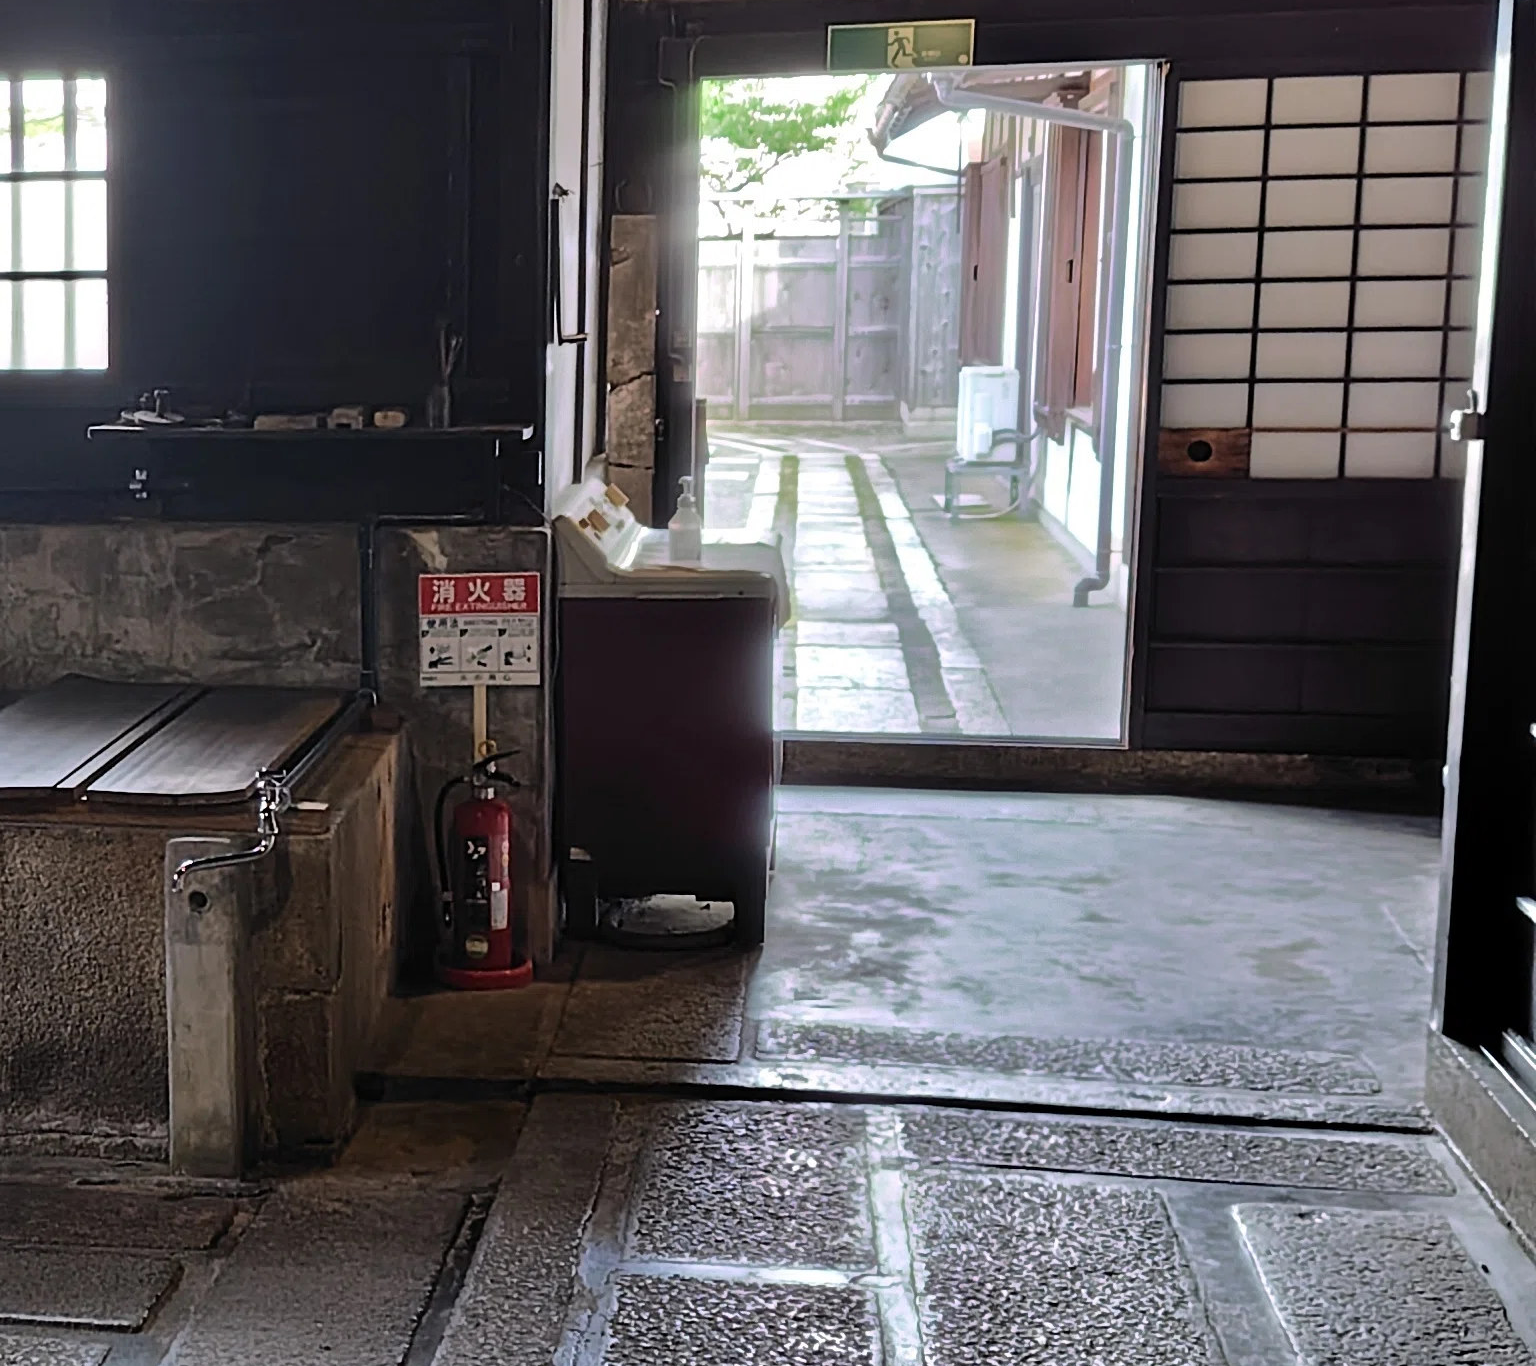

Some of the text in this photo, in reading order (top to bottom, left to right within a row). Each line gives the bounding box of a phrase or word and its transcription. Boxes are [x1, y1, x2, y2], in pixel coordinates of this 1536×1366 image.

[432, 578, 526, 604] 消火器
[430, 601, 528, 612] FIRE EXTINGUISHER
